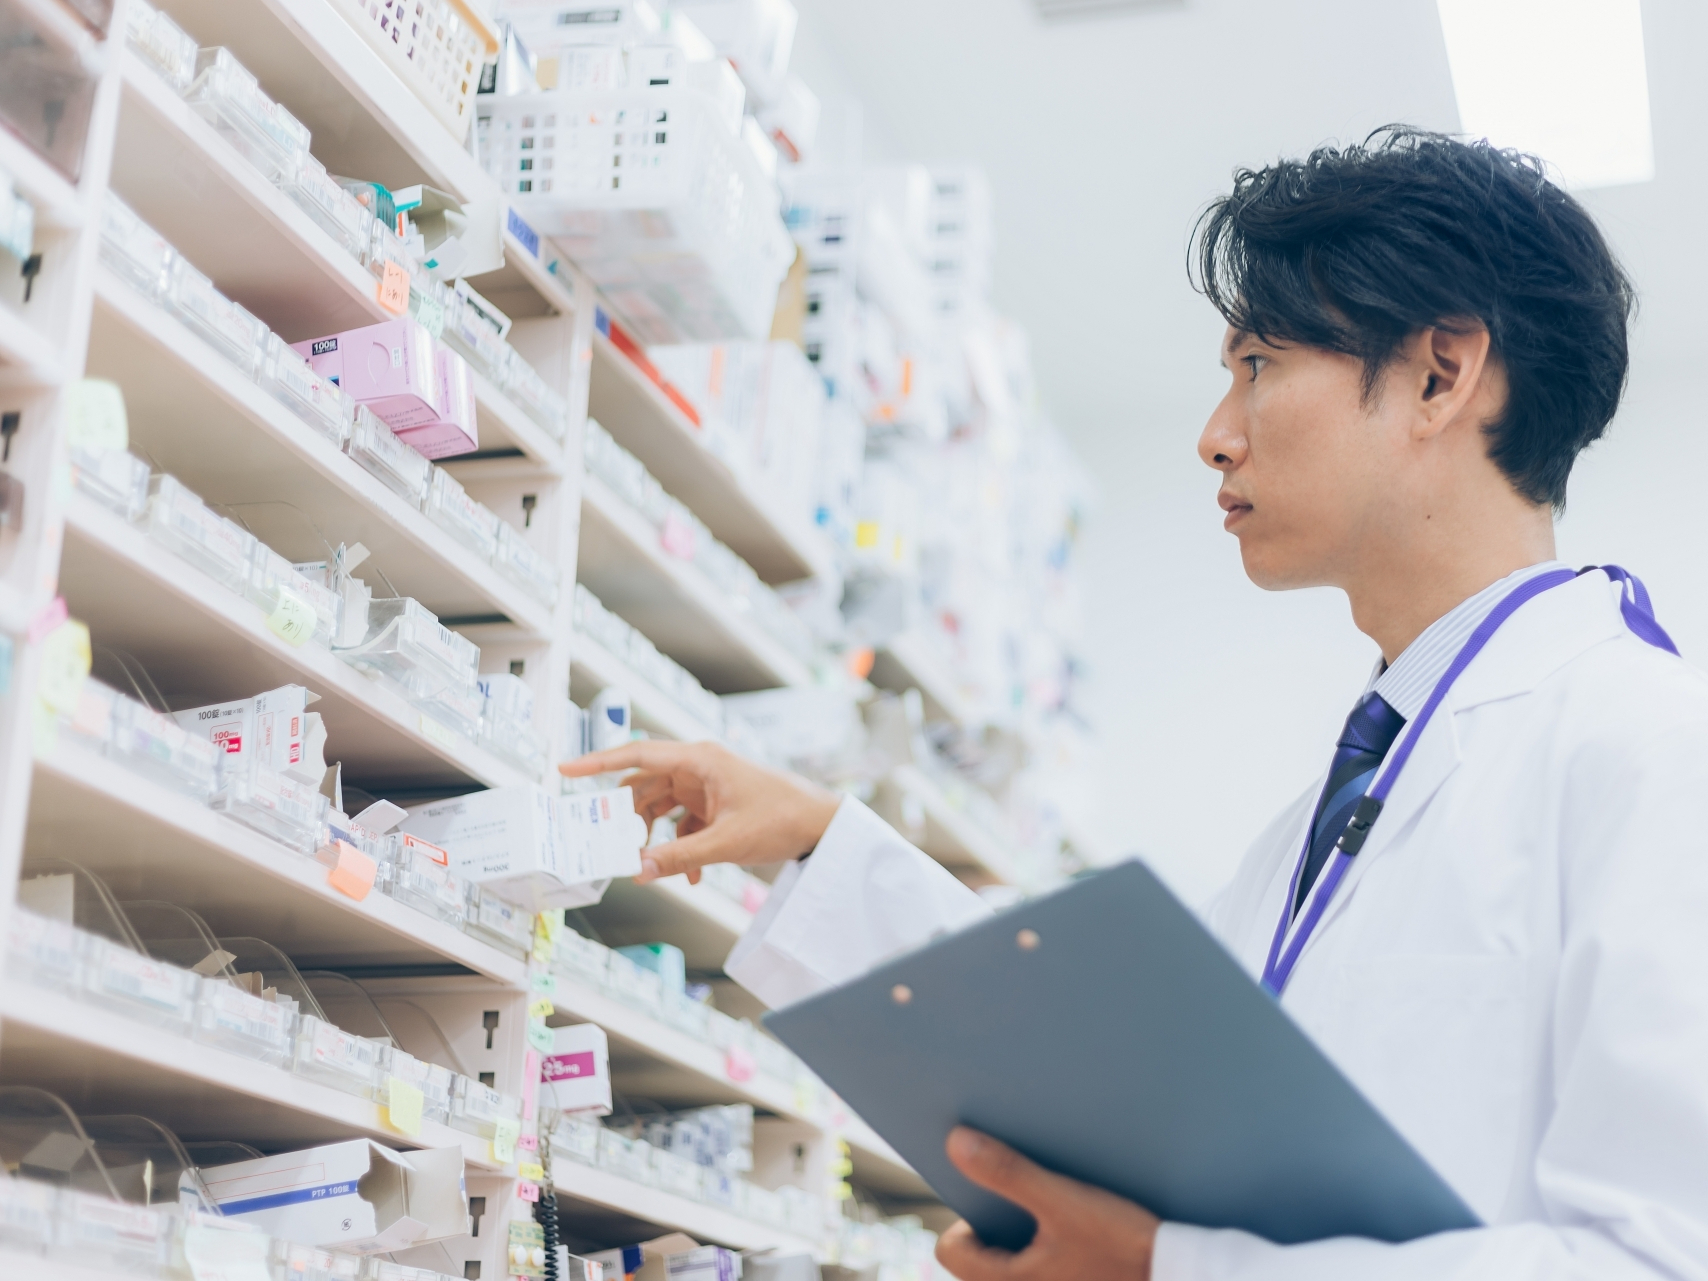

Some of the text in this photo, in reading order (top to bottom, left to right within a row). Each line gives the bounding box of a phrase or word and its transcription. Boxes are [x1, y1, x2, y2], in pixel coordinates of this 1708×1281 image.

[198, 709, 220, 721] 100錠
[214, 731, 239, 740] 100mg
[290, 746, 299, 759] HD
[312, 1189, 326, 1198] PTP
